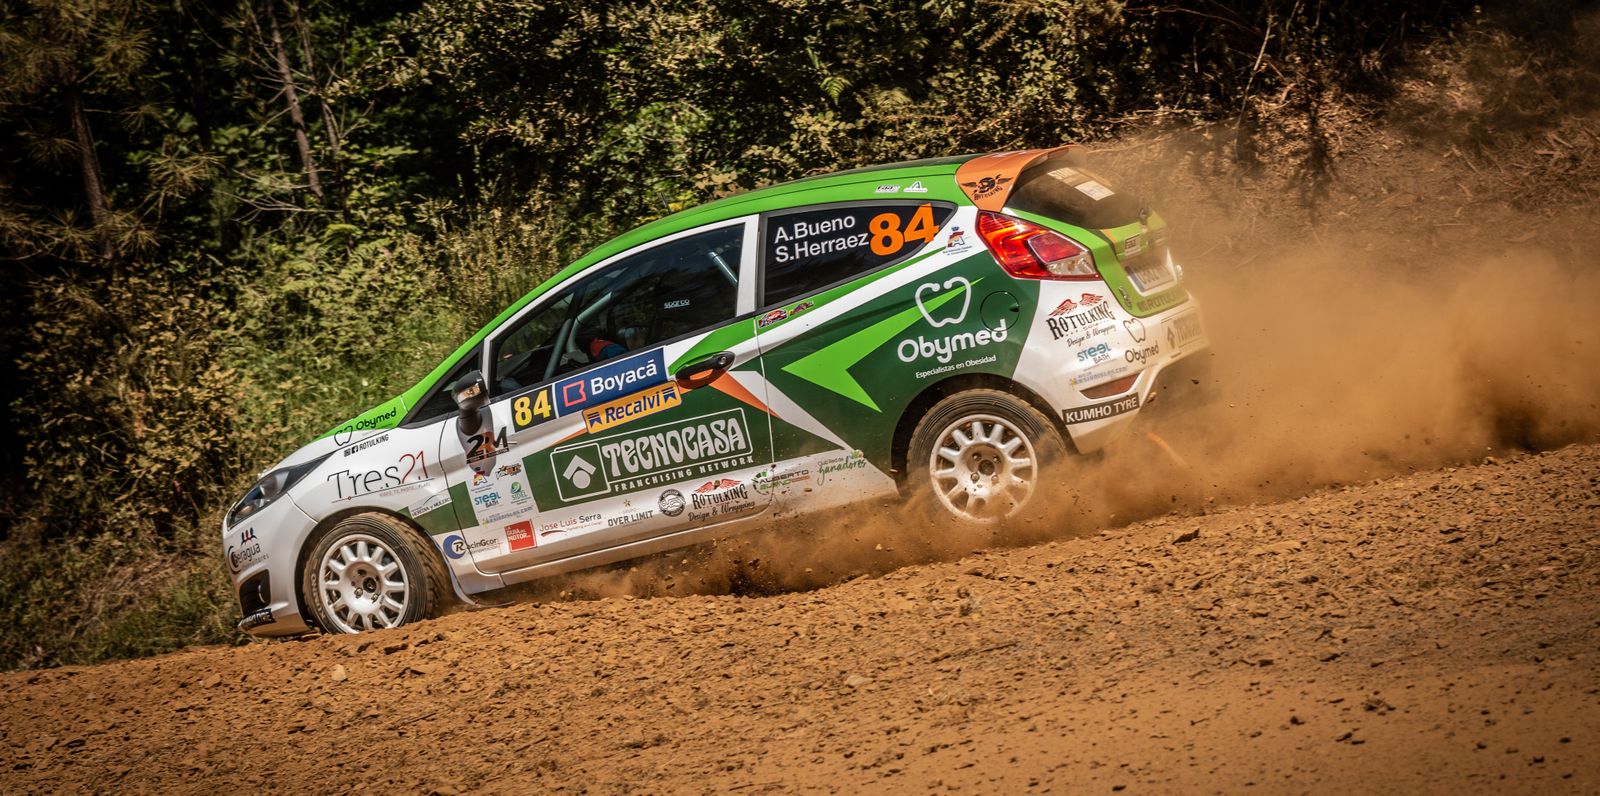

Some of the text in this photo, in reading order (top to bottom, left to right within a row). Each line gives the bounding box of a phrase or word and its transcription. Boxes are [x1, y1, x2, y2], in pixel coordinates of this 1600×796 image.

[774, 215, 855, 244] A.Bueno
[868, 202, 940, 256] 84
[775, 232, 869, 263] S.Herraez
[1045, 300, 1116, 341] ROTULKING
[897, 318, 1008, 364] Obymed
[1124, 340, 1160, 365] Obymed
[590, 359, 657, 396] Boyacá
[915, 354, 997, 379] Especialistas en Obesidad
[356, 407, 397, 431] Obymed
[513, 389, 552, 427] 84
[604, 391, 661, 424] Recalvi
[1064, 396, 1138, 423] KUMHO TYRE
[359, 434, 389, 451] ROTULKING
[601, 417, 747, 477] TECNOCASA
[614, 455, 755, 492] FRANCHISING NETWORK
[759, 469, 809, 485] ALBERTO
[691, 483, 749, 510] ROTULKING
[539, 513, 602, 533] Jose Luis Serra
[608, 515, 629, 527] OVER
[631, 510, 654, 523] LIMIT
[688, 512, 710, 522] Design
[711, 507, 718, 516] &
